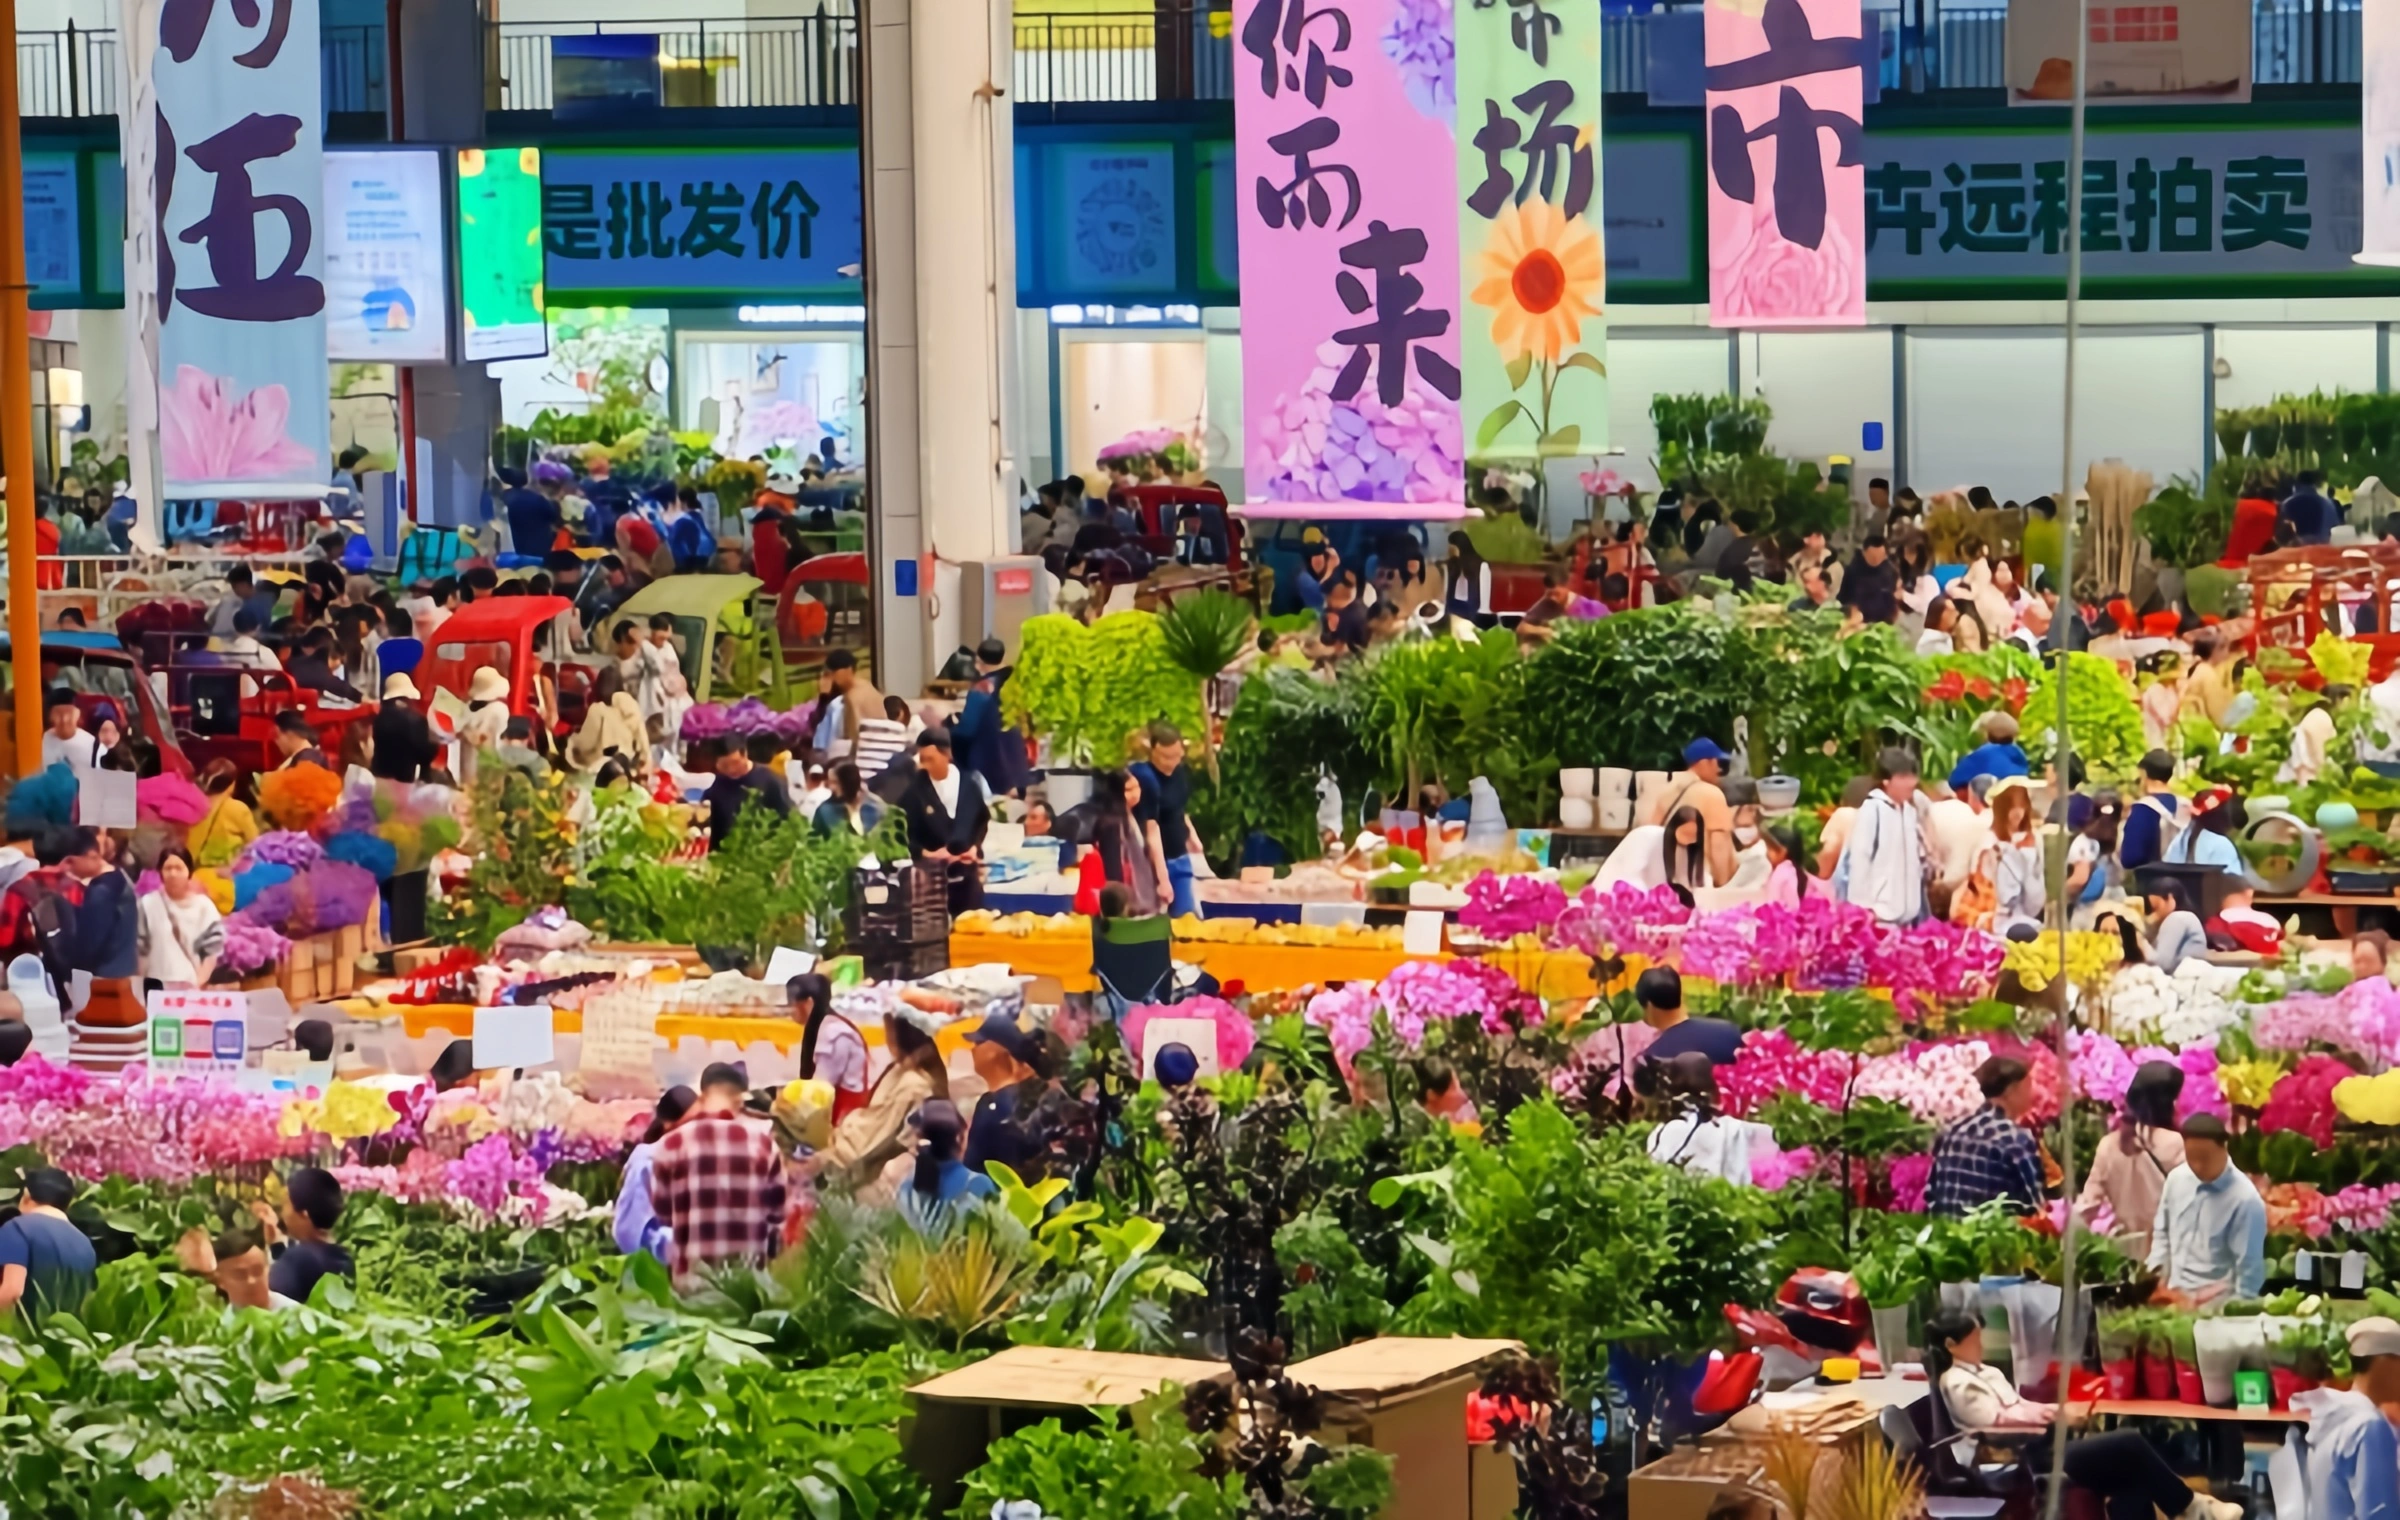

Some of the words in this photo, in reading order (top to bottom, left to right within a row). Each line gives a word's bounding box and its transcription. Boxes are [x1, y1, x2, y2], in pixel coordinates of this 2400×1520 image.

[544, 180, 820, 259] 是批发价
[1242, 0, 1461, 408] 你而来
[1705, 0, 1863, 251] 市
